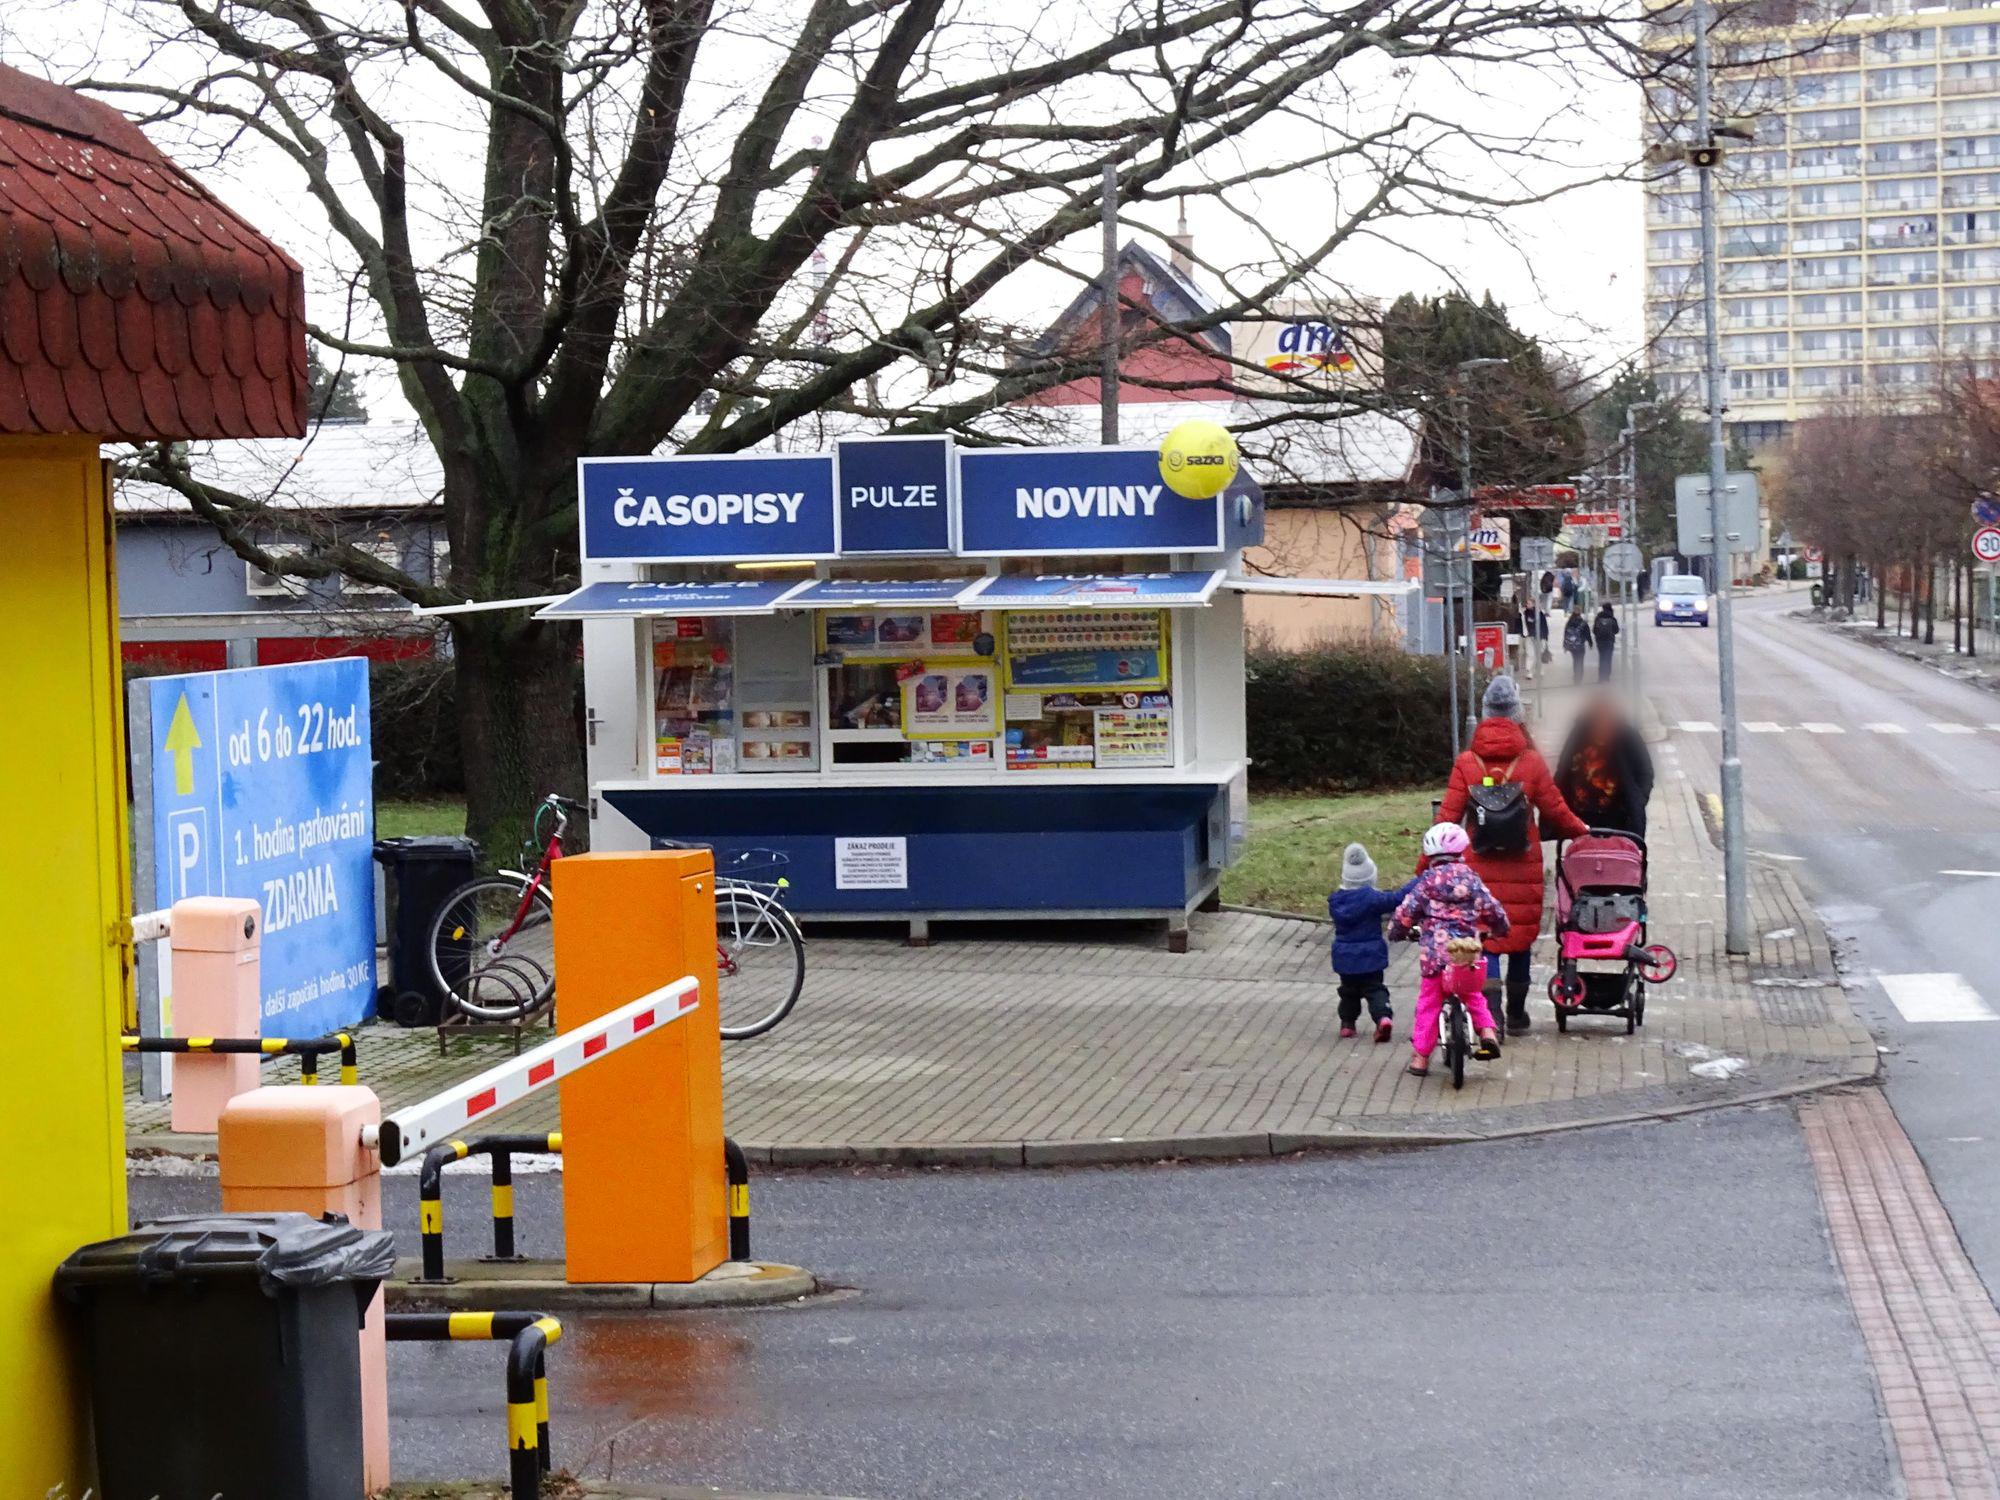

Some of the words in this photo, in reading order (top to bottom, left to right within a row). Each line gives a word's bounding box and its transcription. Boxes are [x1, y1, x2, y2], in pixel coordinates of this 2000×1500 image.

[1186, 456, 1224, 466] sazka
[614, 488, 804, 527] ČASOPISY
[851, 485, 937, 508] PULZE
[1016, 485, 1163, 518] NOVINY
[1980, 536, 2000, 552] 30
[229, 723, 250, 766] od
[257, 707, 271, 761] 6
[275, 714, 292, 759] do
[297, 702, 323, 755] 22
[328, 704, 361, 749] hod.
[235, 829, 248, 865] 1.
[254, 821, 295, 861] hodina
[298, 801, 364, 859] parkování
[178, 822, 199, 898] P
[263, 864, 338, 934] ZDARMA
[265, 989, 286, 1017] další
[320, 970, 346, 996] hodina
[346, 965, 359, 991] 30
